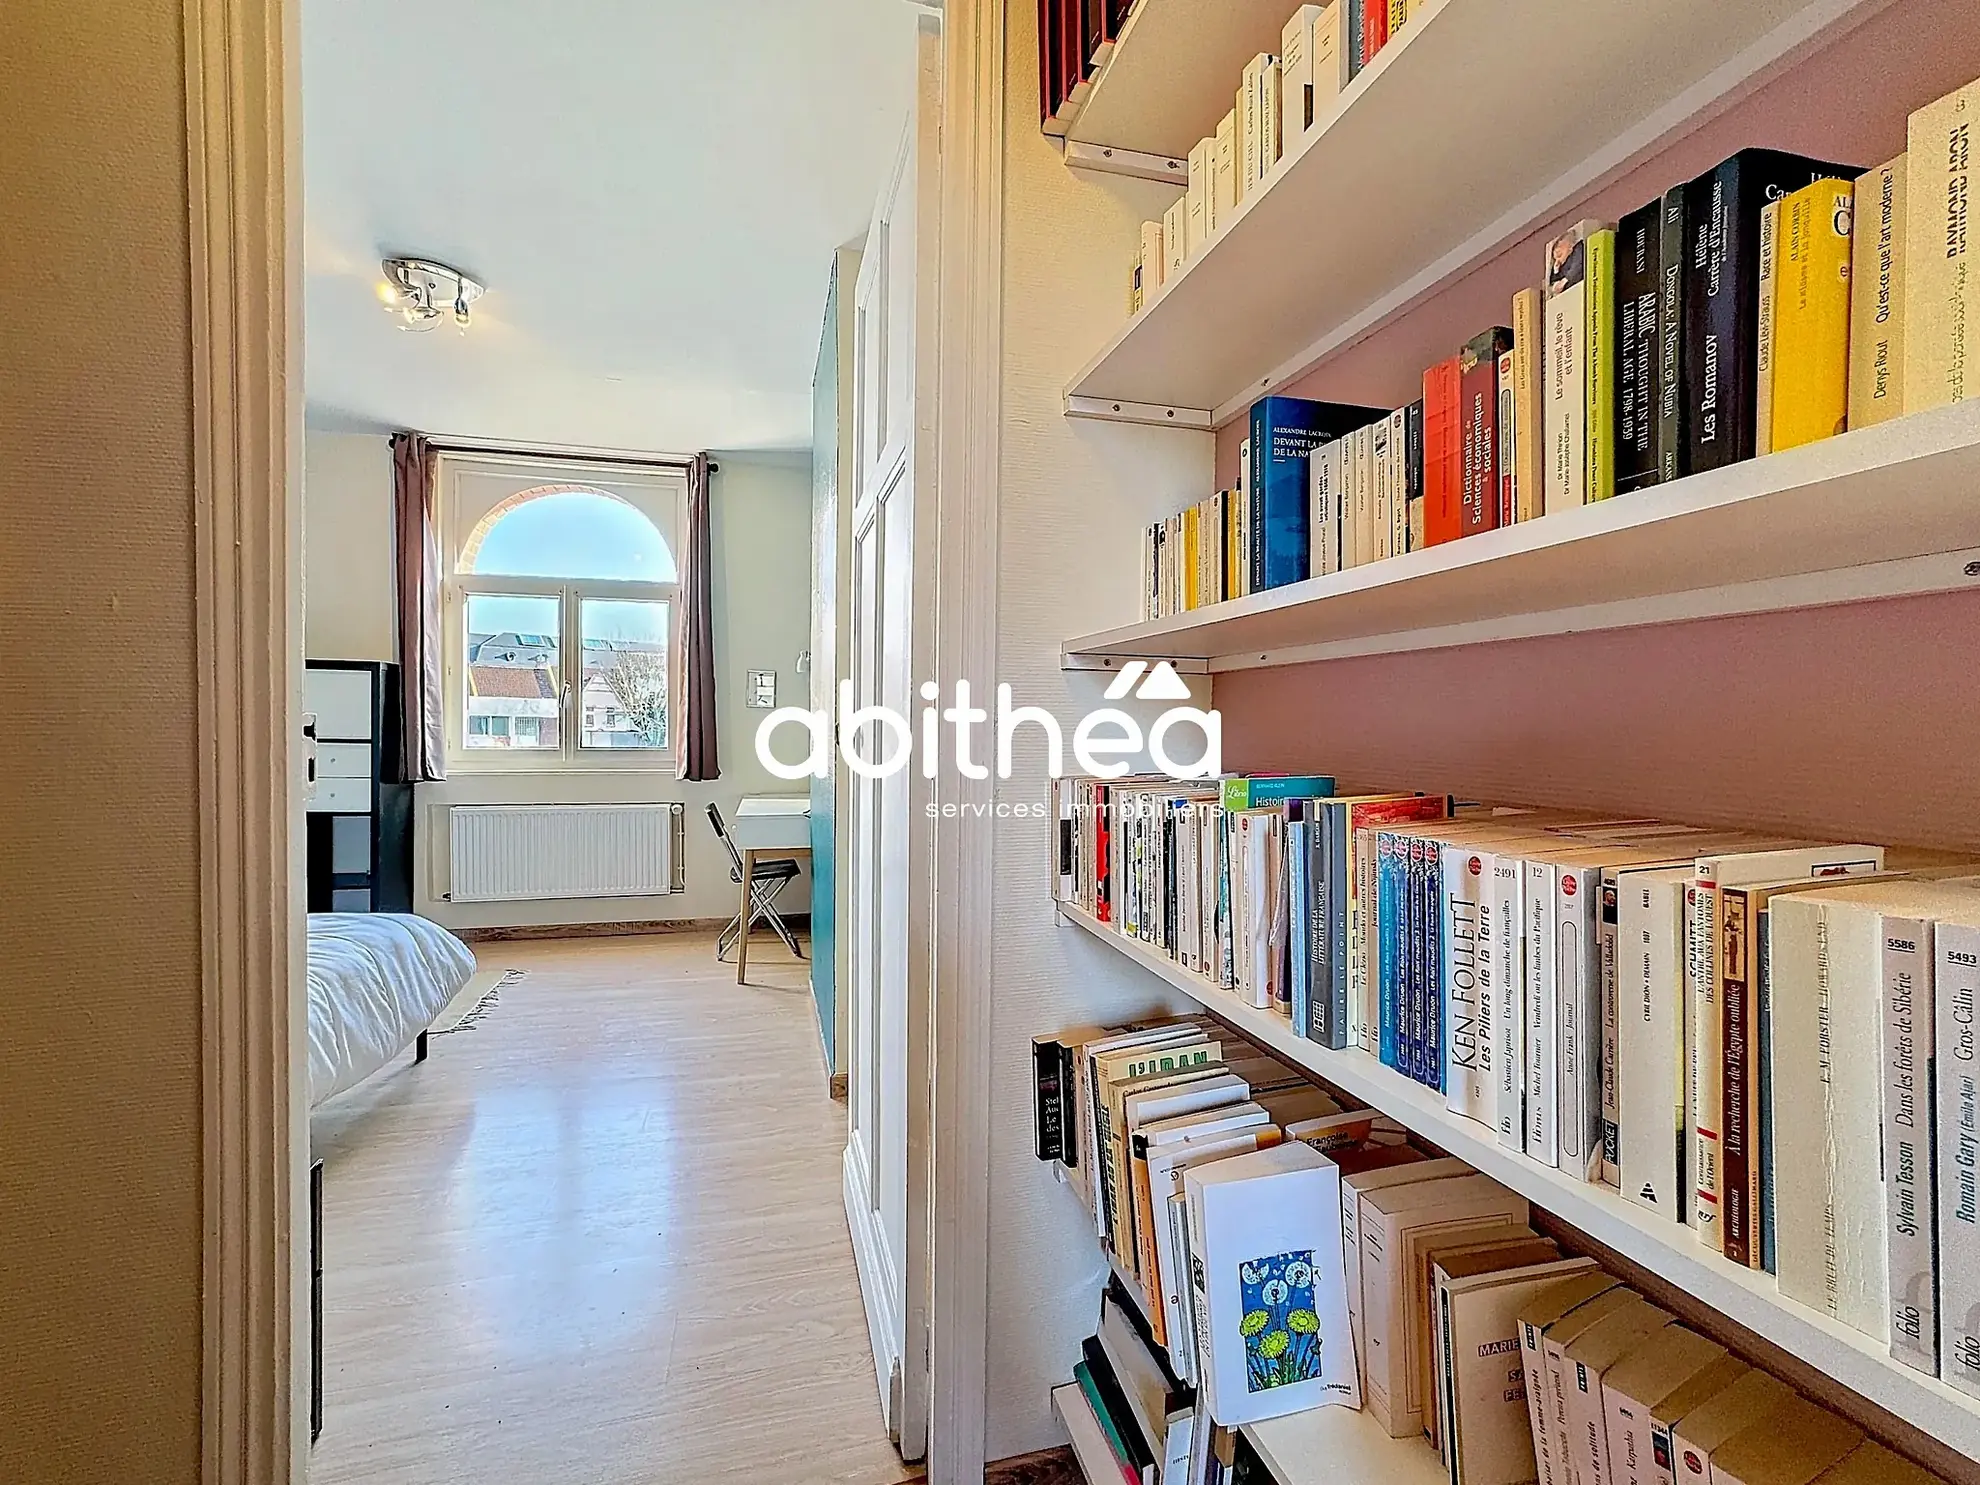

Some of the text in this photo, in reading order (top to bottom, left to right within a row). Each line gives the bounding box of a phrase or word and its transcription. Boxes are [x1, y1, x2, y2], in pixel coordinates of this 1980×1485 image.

[1666, 206, 1679, 223] Ali
[1878, 176, 1892, 224] moderne
[1694, 224, 1709, 268] Hélène
[1706, 180, 1723, 297] Carrère d'Encausse
[1790, 202, 1801, 262] ALAIN CORBIN
[1876, 225, 1891, 250] l'art
[1877, 251, 1895, 272] que
[1759, 212, 1772, 372] Claude Race et histoire
[1800, 302, 1808, 310] Le
[1875, 273, 1890, 323] Qu'est-ce
[1664, 320, 1676, 332] A
[1554, 312, 1565, 401] Le sommeil, le rêve
[1563, 326, 1574, 376] et l'enfant
[1664, 332, 1677, 369] NOVEL
[1874, 339, 1888, 367] Riout
[1622, 300, 1634, 440] LIBERAL AGE 1798-1939
[1636, 292, 1657, 451] ARABIC THOUGHT IN THE
[1664, 369, 1674, 383] OF
[1874, 370, 1890, 399] Denys
[1664, 382, 1677, 418] NUBIA
[1700, 334, 1718, 444] Les Romanov
[1272, 426, 1307, 436] ALEXANDRE
[1273, 437, 1307, 448] DEVANT
[1307, 440, 1317, 448] LA
[1273, 448, 1286, 456] DE
[1286, 448, 1297, 458] LA
[1472, 392, 1484, 525] Sciences économiques
[1482, 426, 1493, 473] sociales
[1463, 432, 1474, 505] Dictionnaire
[1255, 796, 1287, 807] Histoir
[1494, 867, 1516, 879] 2491
[1533, 867, 1542, 878] 12
[1698, 865, 1710, 875] 21
[1532, 898, 1543, 933] Pacifique
[1310, 908, 1319, 963] HISTOIRE DE LA
[1532, 934, 1542, 945] du
[1696, 938, 1706, 957] AUX
[1704, 894, 1715, 1004] DES COLLINES DE L'OUEST
[1888, 938, 1915, 953] 5586
[1338, 966, 1344, 979] LE
[1532, 946, 1542, 972] limbes
[1947, 950, 1976, 966] 5493
[1360, 976, 1367, 986] Le
[1449, 892, 1478, 1072] KEN FOLLETT
[1478, 906, 1491, 1072] Les Piliers de la Terre
[1532, 973, 1542, 983] les
[1532, 984, 1542, 993] ou
[1642, 952, 1651, 1022] CYRIL DION DEMAIN
[1502, 900, 1513, 1093] Sébastien Japrisot Un long dimanche de fiançailles
[1532, 995, 1542, 1029] Vendredi
[1565, 1003, 1575, 1076] Anne Frank Journal
[1818, 1006, 1830, 1055] FORSTER
[1532, 1037, 1542, 1071] Tournier
[1604, 969, 1616, 1164] POCKET Jean-Claude Carrière La de
[1723, 984, 1742, 1156] À la recherche de l'Égypte oubliée
[1532, 1072, 1542, 1098] Michel
[1892, 972, 1921, 1341] folio Sylvain Tesson Dans les forêts de Sibérie
[1954, 988, 1980, 1371] folio Romain Gary Gros-Câlin
[1480, 1339, 1520, 1356] MARIE
[1526, 1325, 1534, 1348] POINTS
[1578, 1366, 1586, 1390] POINTS
[1532, 1369, 1546, 1434] femme-araignée
[1542, 1448, 1549, 1458] de
[1587, 1421, 1600, 1472] de solitude
